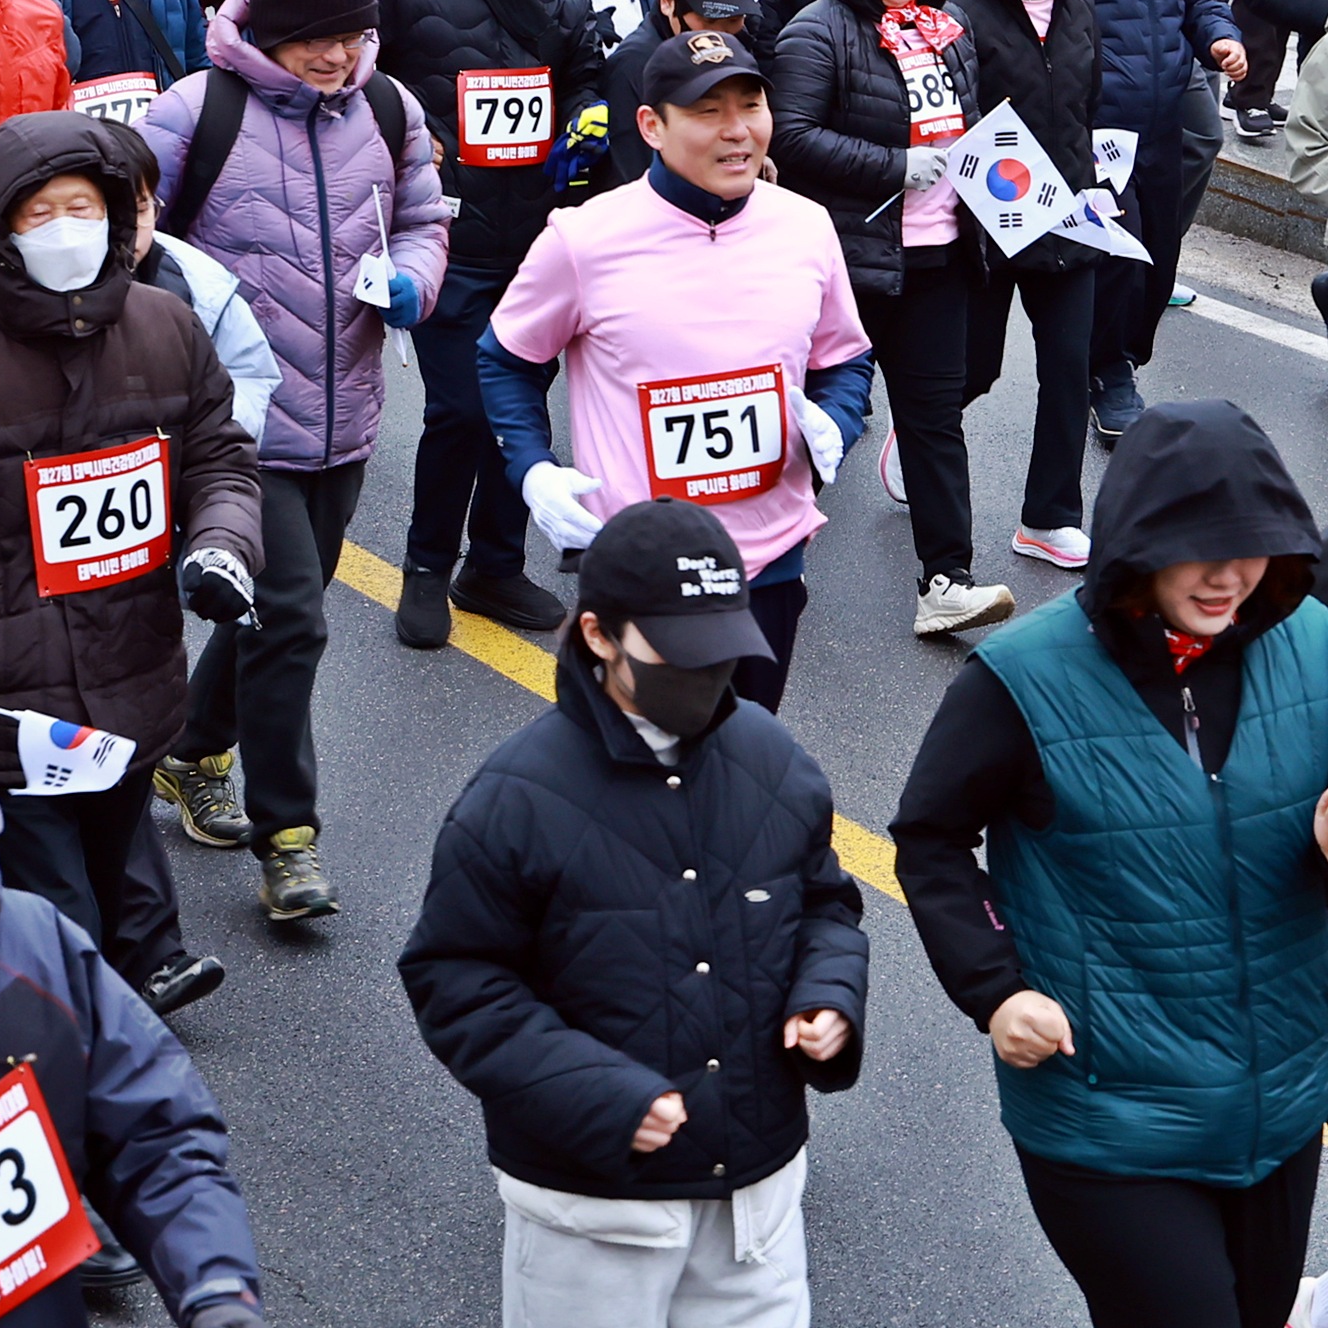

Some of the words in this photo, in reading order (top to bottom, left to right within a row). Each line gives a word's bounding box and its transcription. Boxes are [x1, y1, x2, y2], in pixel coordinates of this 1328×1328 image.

[476, 96, 543, 135] 799
[664, 405, 760, 464] 751
[56, 479, 152, 548] 260
[680, 582, 702, 597] Be
